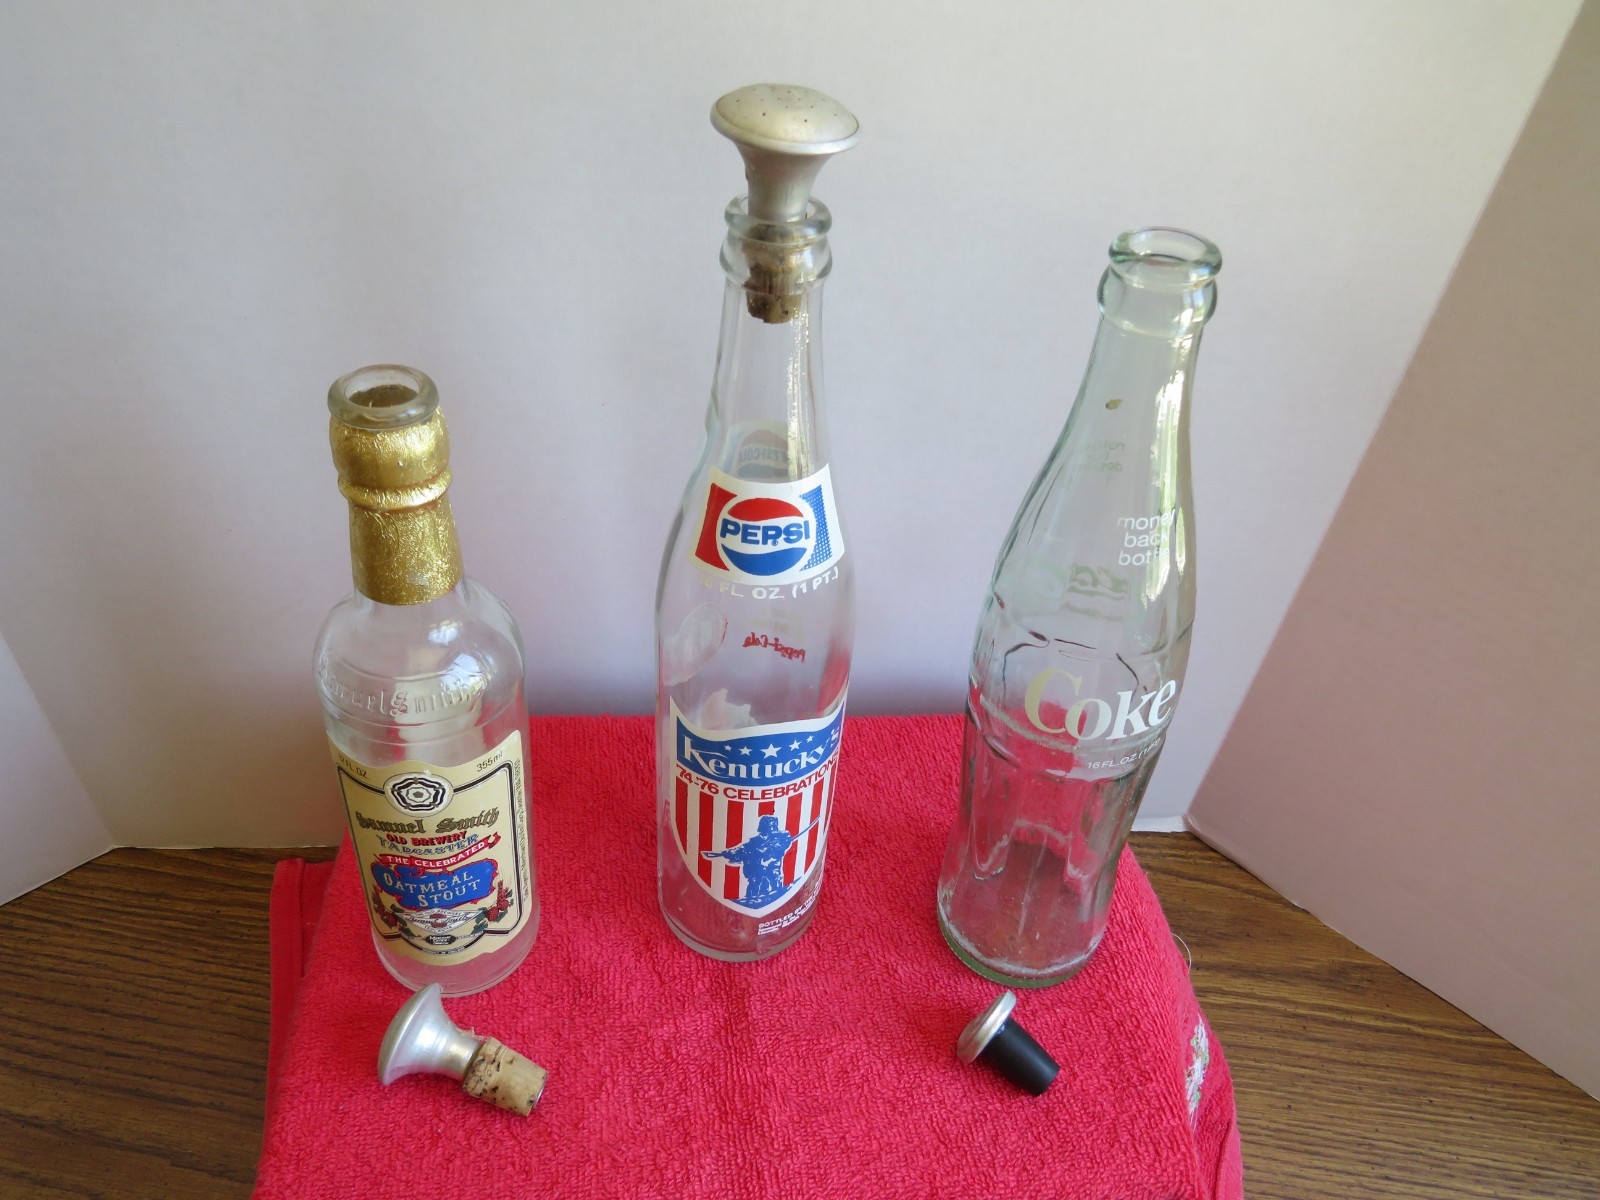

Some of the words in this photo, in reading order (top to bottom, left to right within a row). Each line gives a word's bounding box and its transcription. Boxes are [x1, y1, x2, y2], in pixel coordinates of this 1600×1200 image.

[720, 517, 810, 546] PEPSI
[1116, 508, 1176, 531] money
[1024, 667, 1177, 741] Coke
[356, 811, 427, 834] Samuel
[435, 807, 500, 834] Smith
[376, 833, 480, 856] TADCASTER
[385, 833, 408, 846] OLD
[411, 830, 468, 847] BREWERY
[387, 855, 409, 865] THE
[414, 841, 486, 868] CELEBRATED
[383, 871, 474, 894] OATMEAL
[417, 878, 481, 907] STOUT
